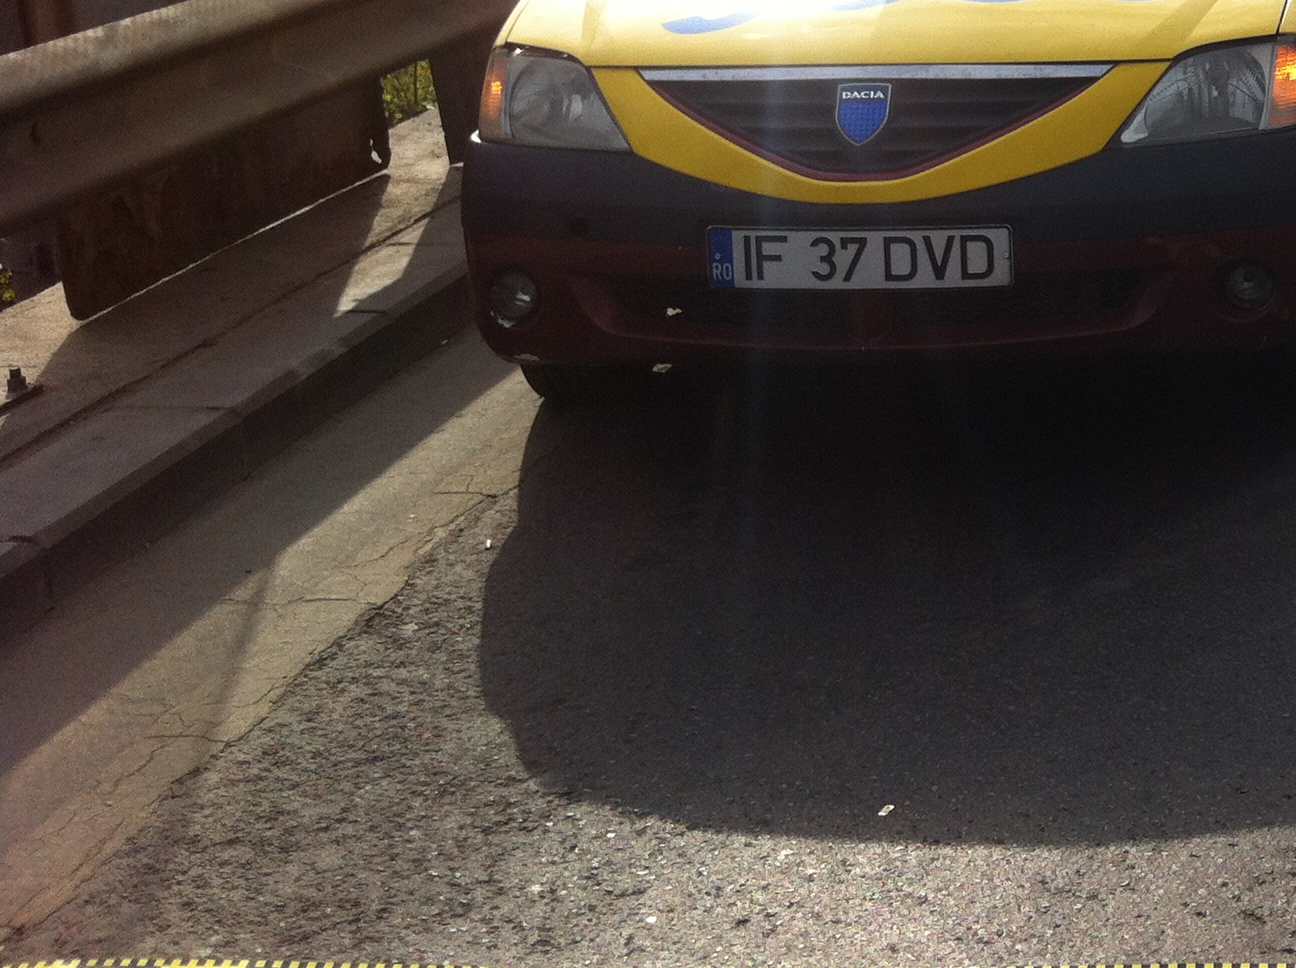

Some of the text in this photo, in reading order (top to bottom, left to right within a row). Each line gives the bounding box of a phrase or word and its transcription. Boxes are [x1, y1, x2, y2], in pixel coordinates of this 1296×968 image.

[842, 90, 886, 99] DACIA
[712, 234, 995, 283] RO IF 37 DVD
